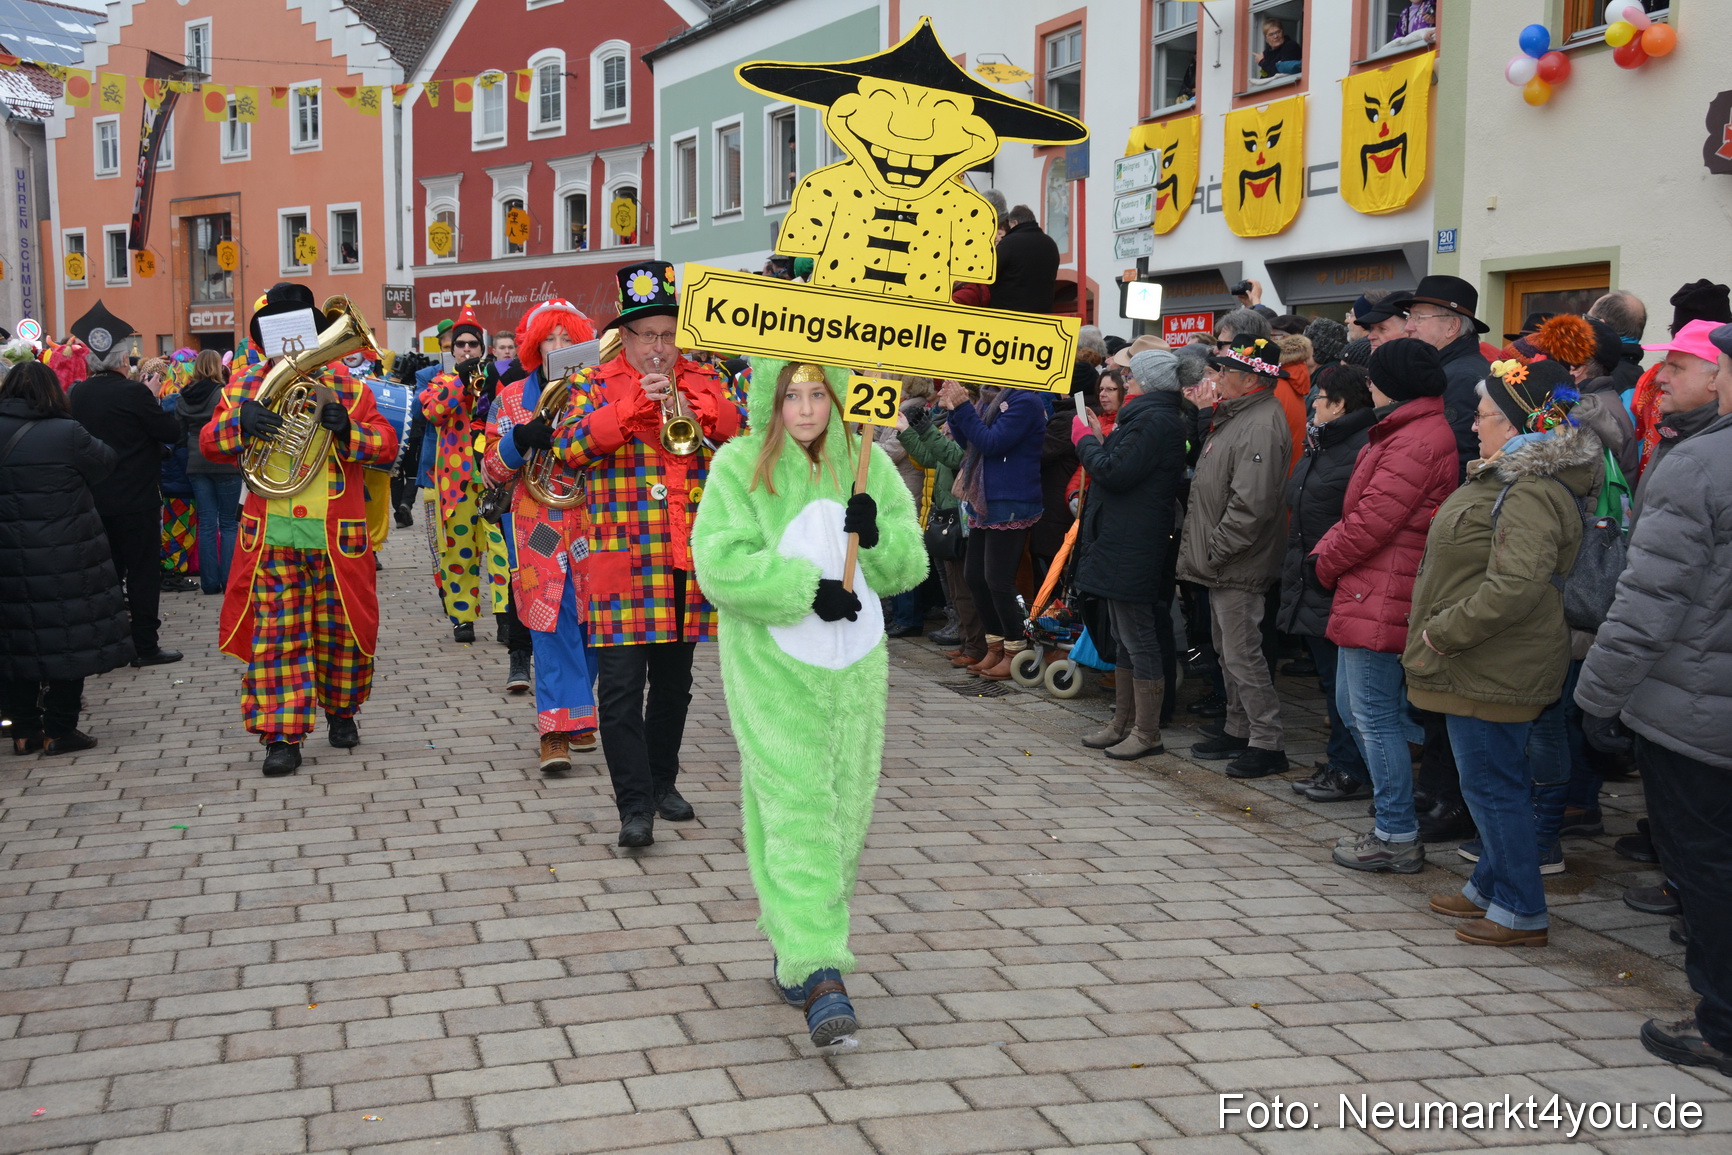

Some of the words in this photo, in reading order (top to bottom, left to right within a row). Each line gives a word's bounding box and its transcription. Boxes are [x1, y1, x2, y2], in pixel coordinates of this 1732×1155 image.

[16, 169, 28, 229] UHREN
[1439, 230, 1453, 243] 20
[20, 237, 32, 319] SCHMUCK
[1333, 264, 1394, 285] UHREN
[386, 288, 411, 302] CAFÉ
[189, 310, 235, 327] GÖTZ
[1180, 317, 1195, 330] WIR
[705, 297, 947, 352] Kolpingskapelle
[957, 328, 1054, 371] Töging
[849, 382, 897, 420] 23
